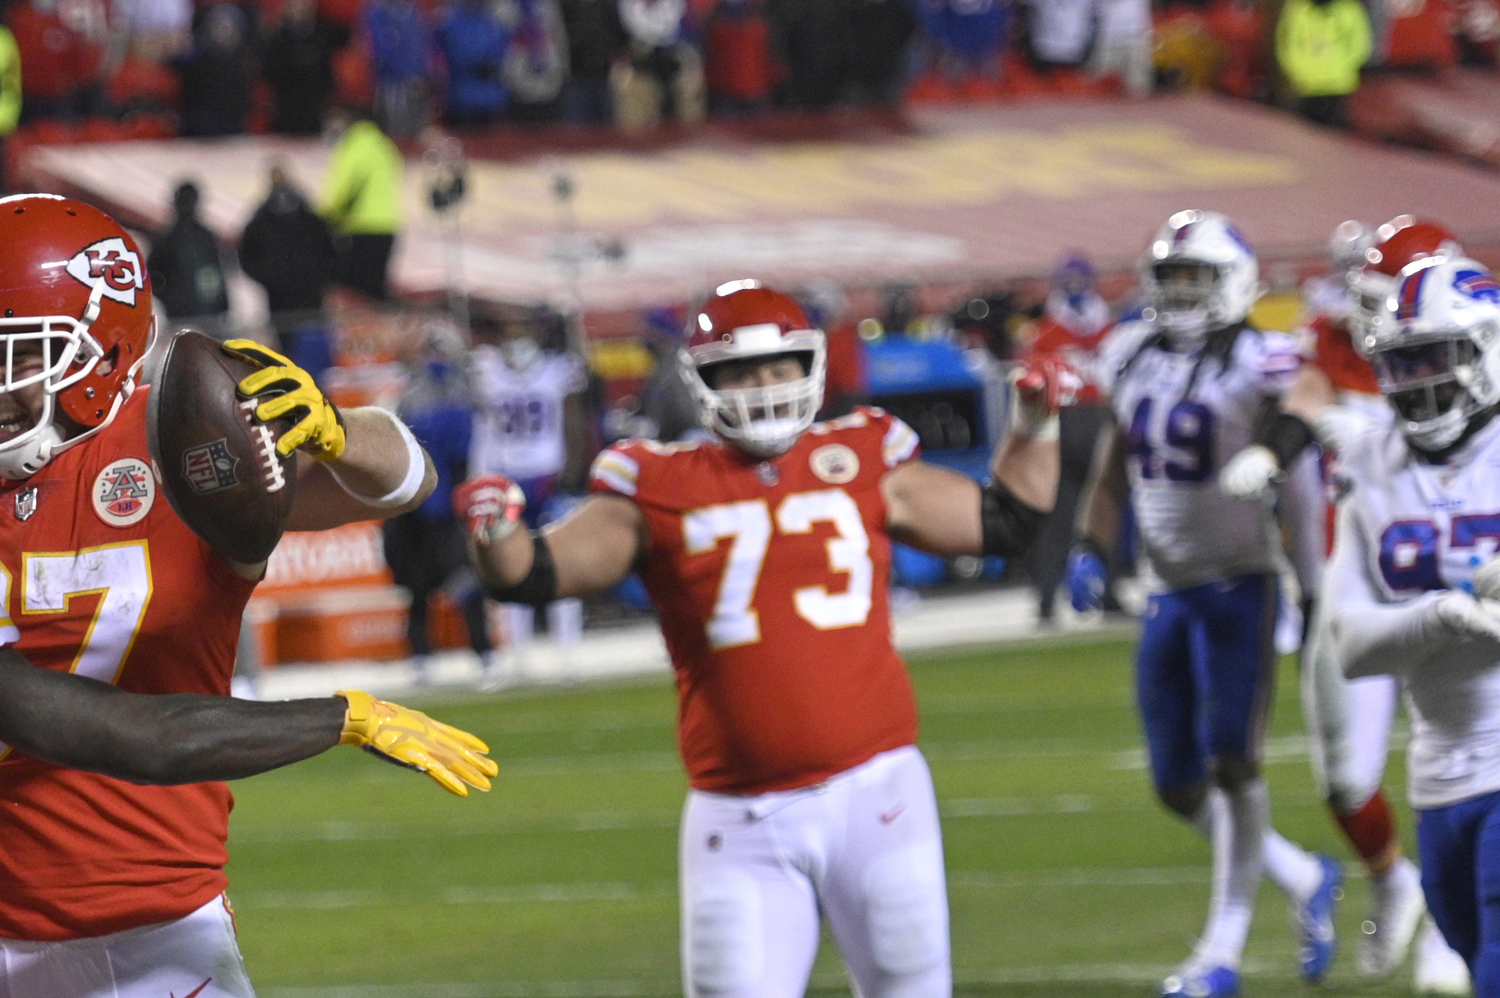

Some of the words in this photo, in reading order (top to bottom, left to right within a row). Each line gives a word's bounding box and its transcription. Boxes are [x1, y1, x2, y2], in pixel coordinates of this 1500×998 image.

[186, 449, 218, 491] NFL
[1127, 397, 1215, 481] 49
[682, 488, 873, 650] 73
